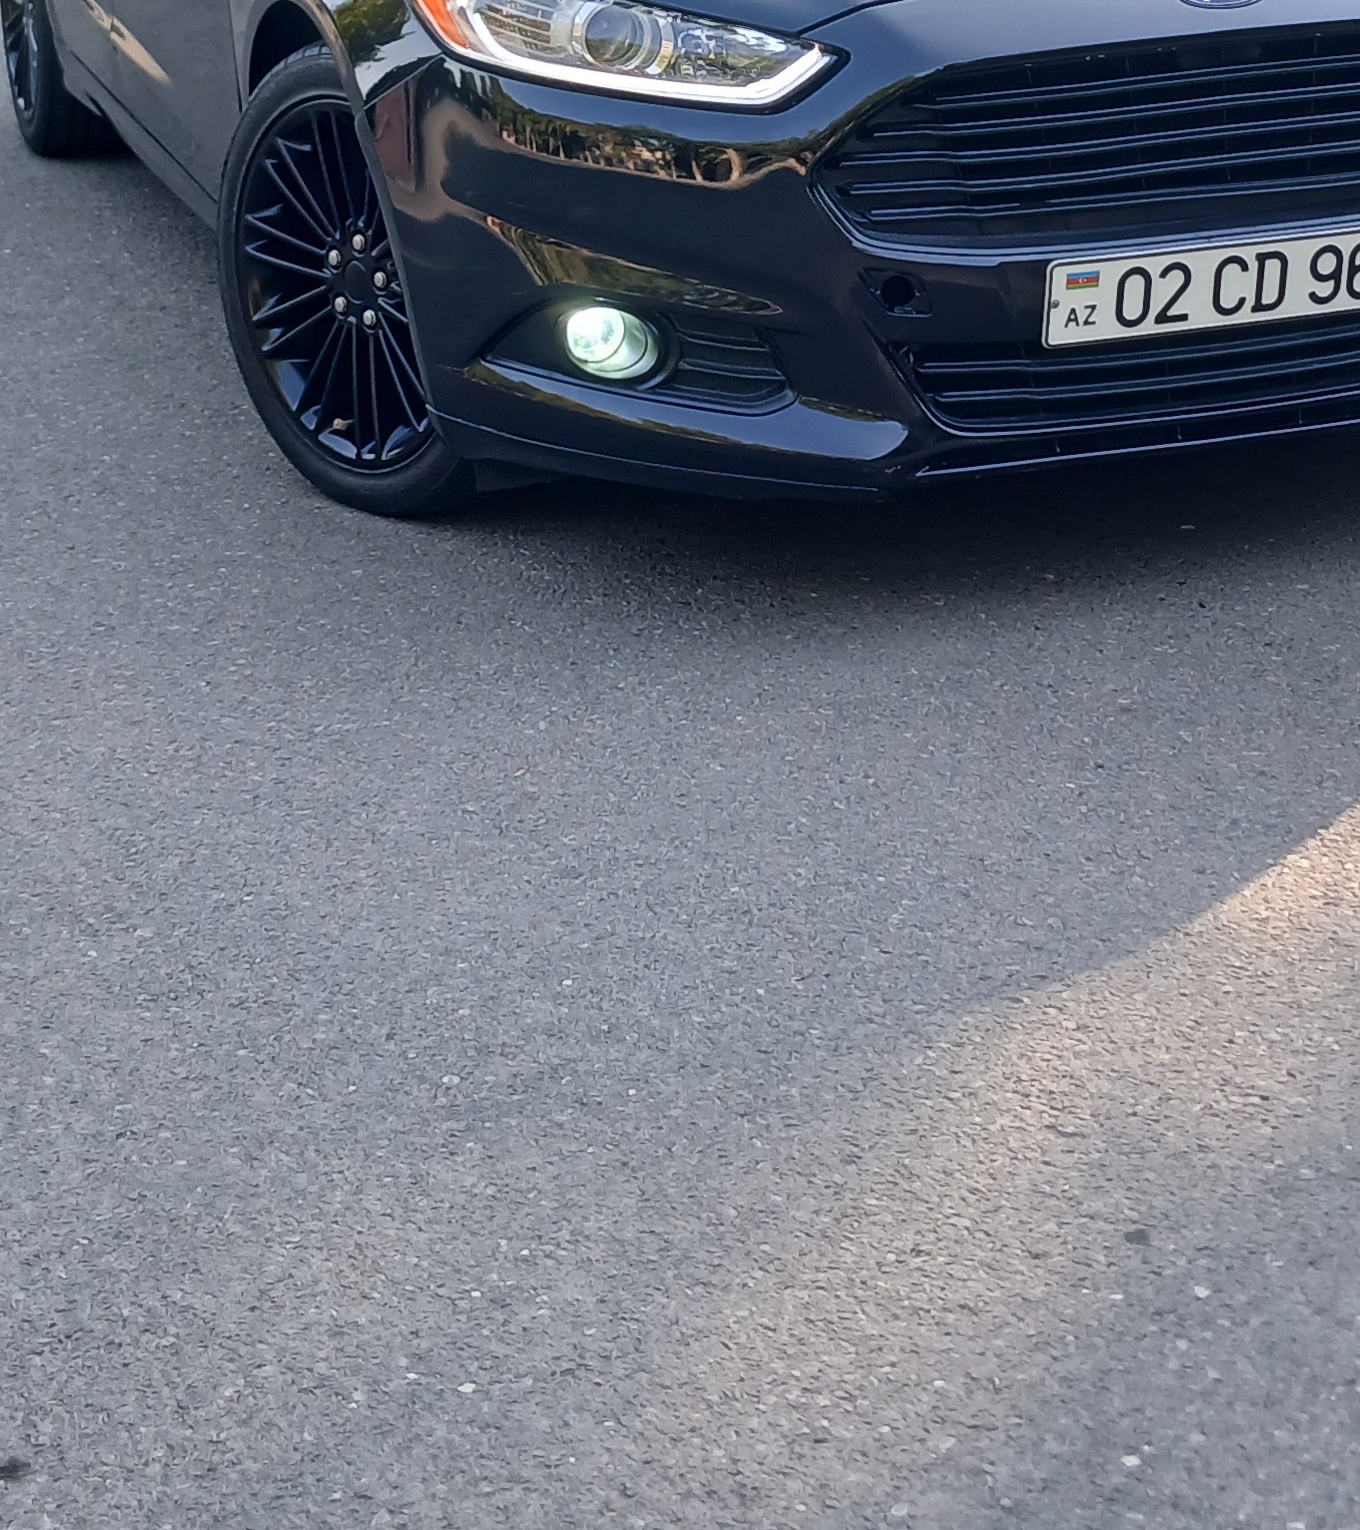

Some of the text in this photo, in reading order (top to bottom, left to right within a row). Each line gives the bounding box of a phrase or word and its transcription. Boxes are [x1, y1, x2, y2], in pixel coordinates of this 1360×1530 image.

[1115, 262, 1192, 328] 02
[1212, 251, 1289, 317] CD
[1064, 305, 1097, 329] AZ
